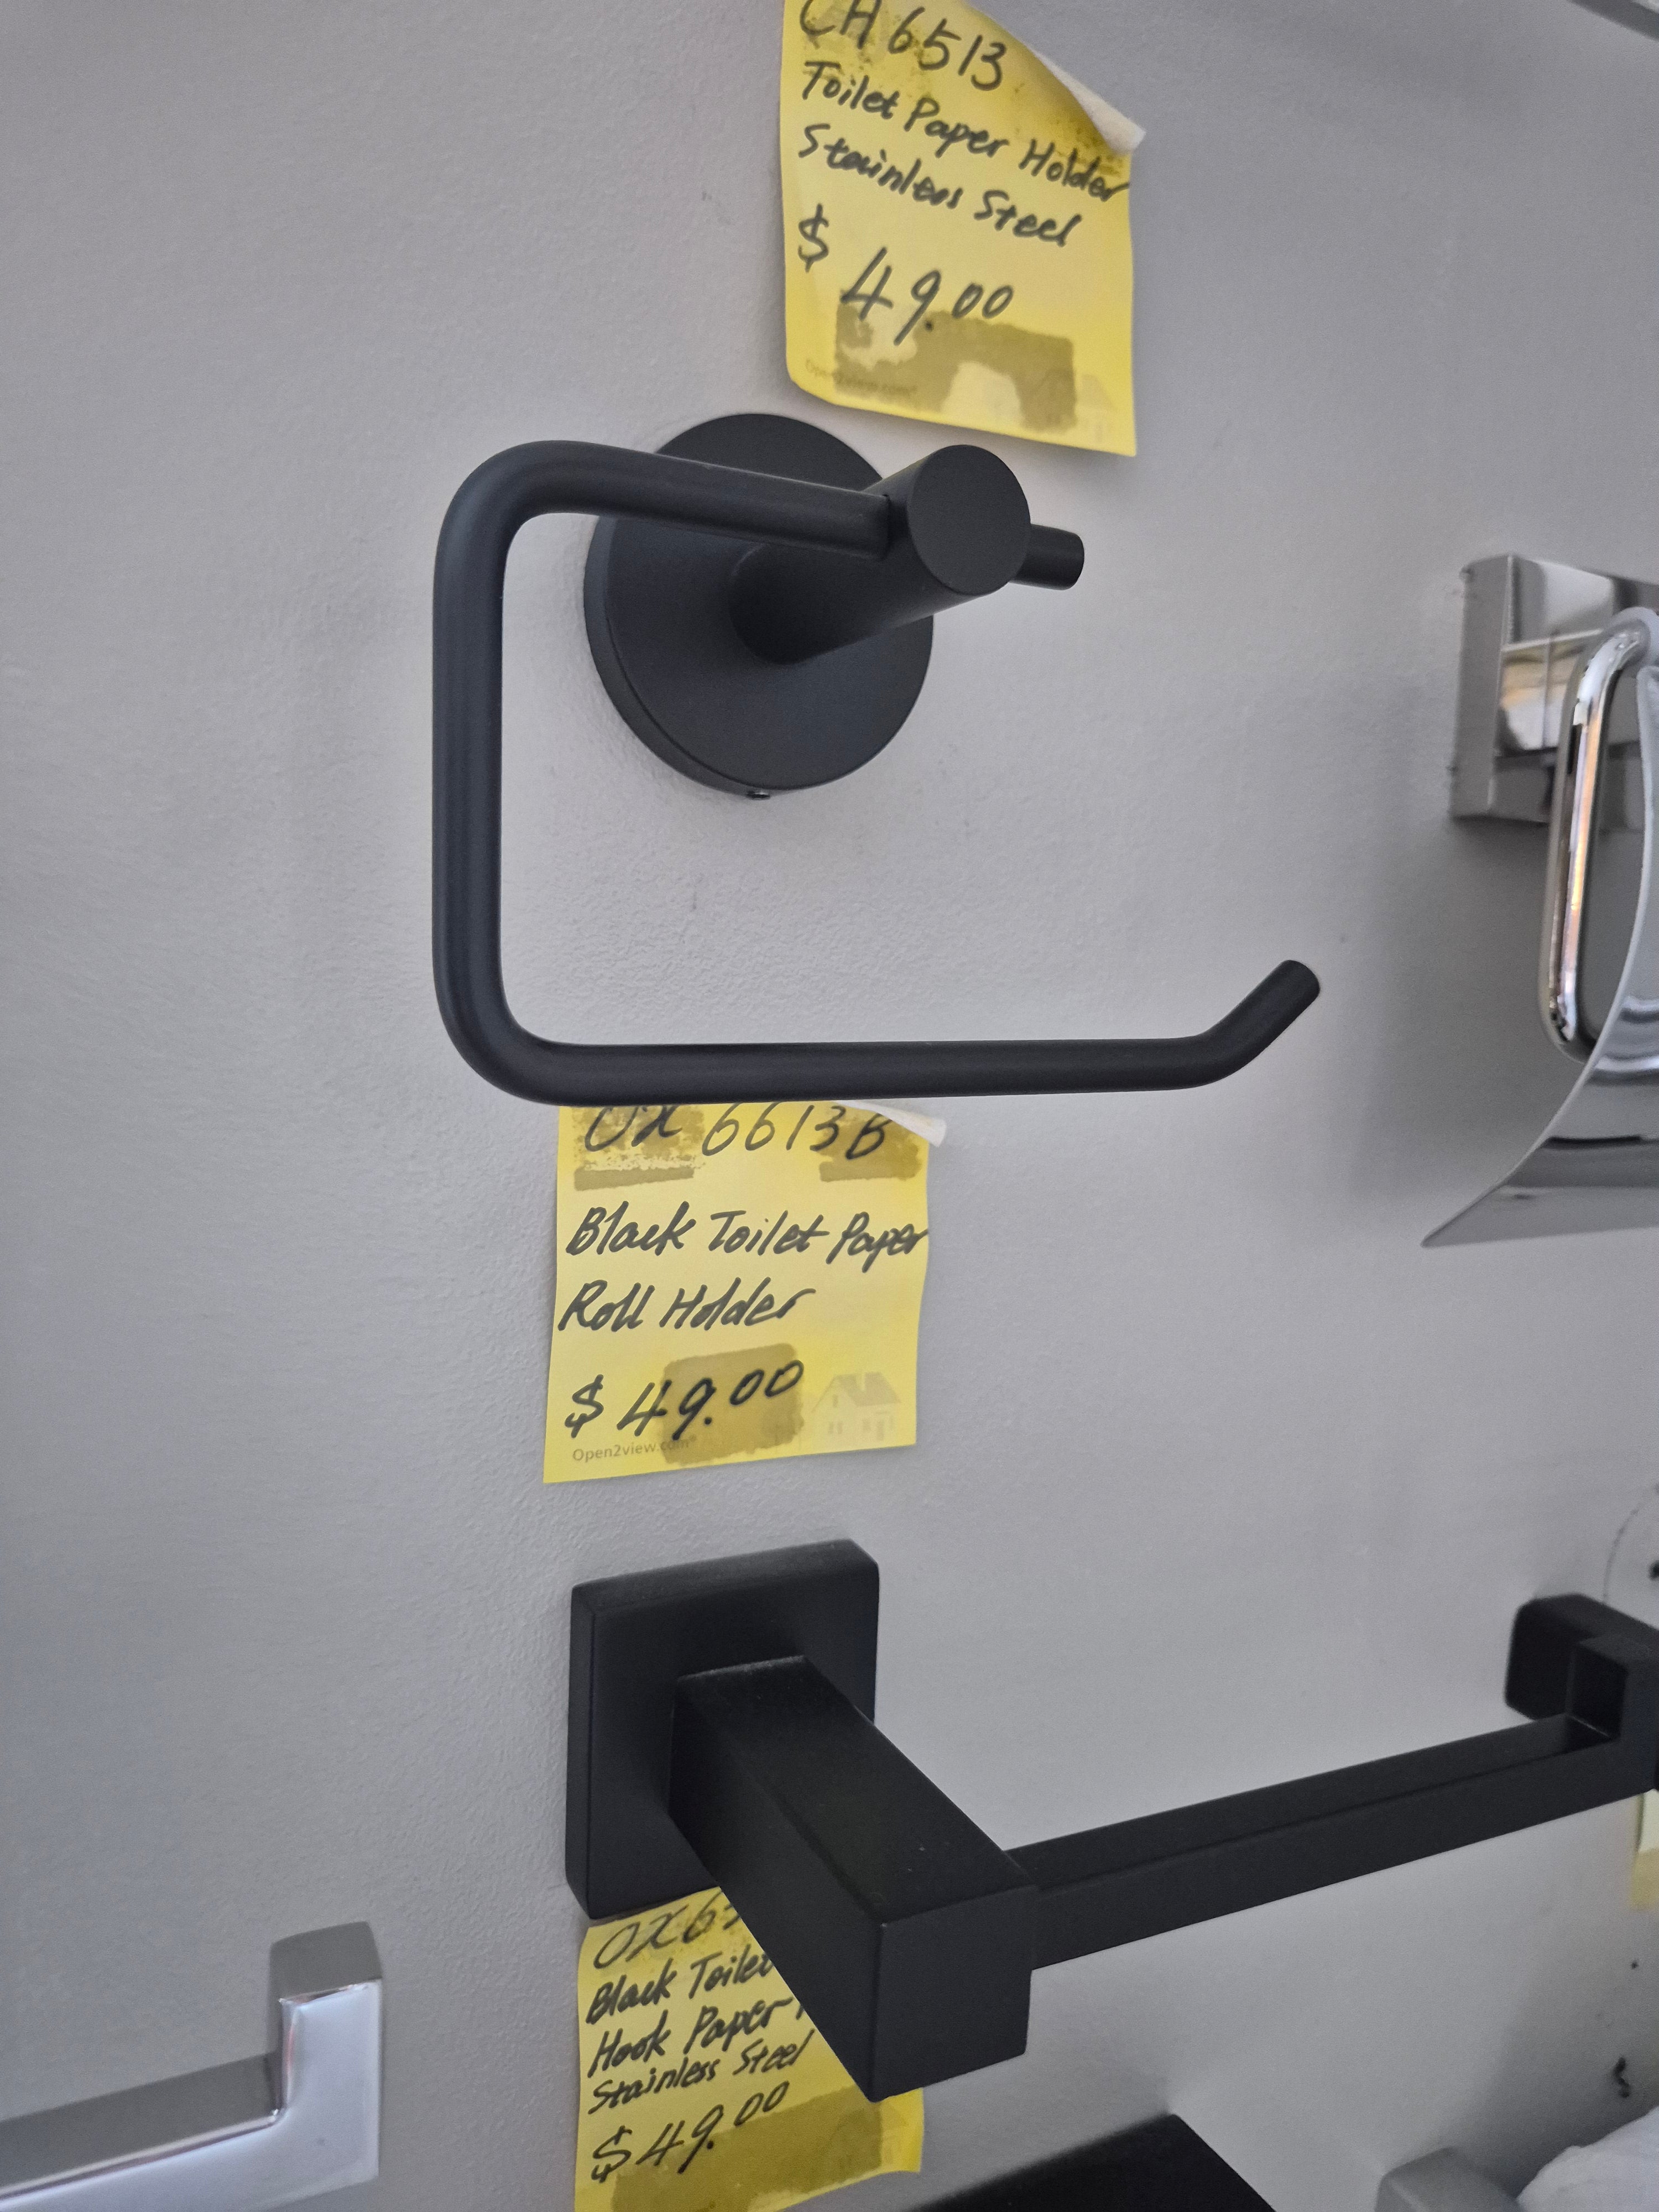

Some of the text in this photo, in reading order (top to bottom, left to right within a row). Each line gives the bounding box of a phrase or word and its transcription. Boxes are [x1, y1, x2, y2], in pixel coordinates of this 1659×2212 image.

[802, 61, 1130, 202] Toilet Paper Holder
[798, 123, 1083, 247] Stainless Steel
[798, 204, 830, 273] $
[566, 1201, 929, 1273] Black Toilet Paper
[557, 1277, 816, 1333] Roll Holder
[594, 1888, 741, 1969] OX6
[585, 1958, 677, 2025] Black
[587, 1996, 794, 2078] Hook Paper
[587, 2028, 815, 2115] Stainless Steel
